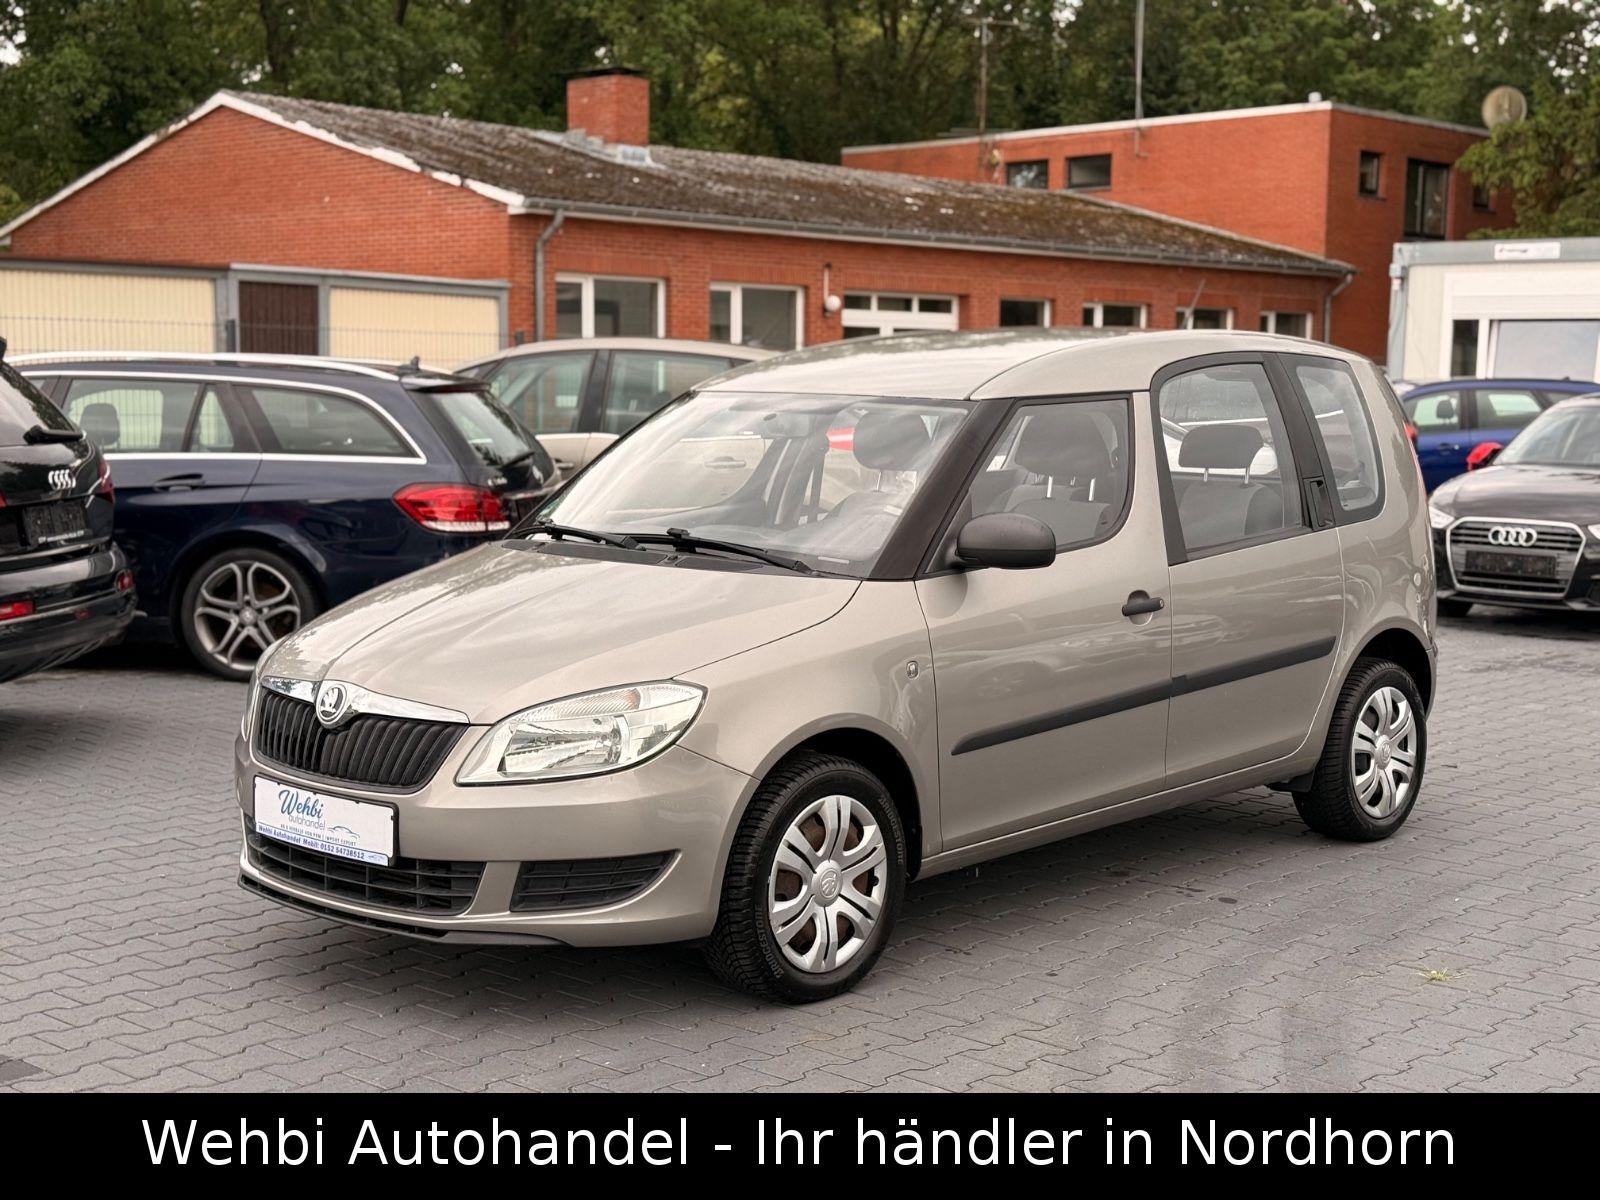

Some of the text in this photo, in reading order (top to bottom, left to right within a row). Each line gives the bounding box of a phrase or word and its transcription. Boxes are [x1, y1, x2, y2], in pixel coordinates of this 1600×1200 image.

[278, 789, 324, 818] Wehbi
[288, 814, 326, 830] autohandel
[878, 796, 904, 865] BRIDGESTONE
[273, 828, 301, 844] Autohandel
[302, 838, 320, 849] Mobil:
[320, 843, 335, 853] 0152
